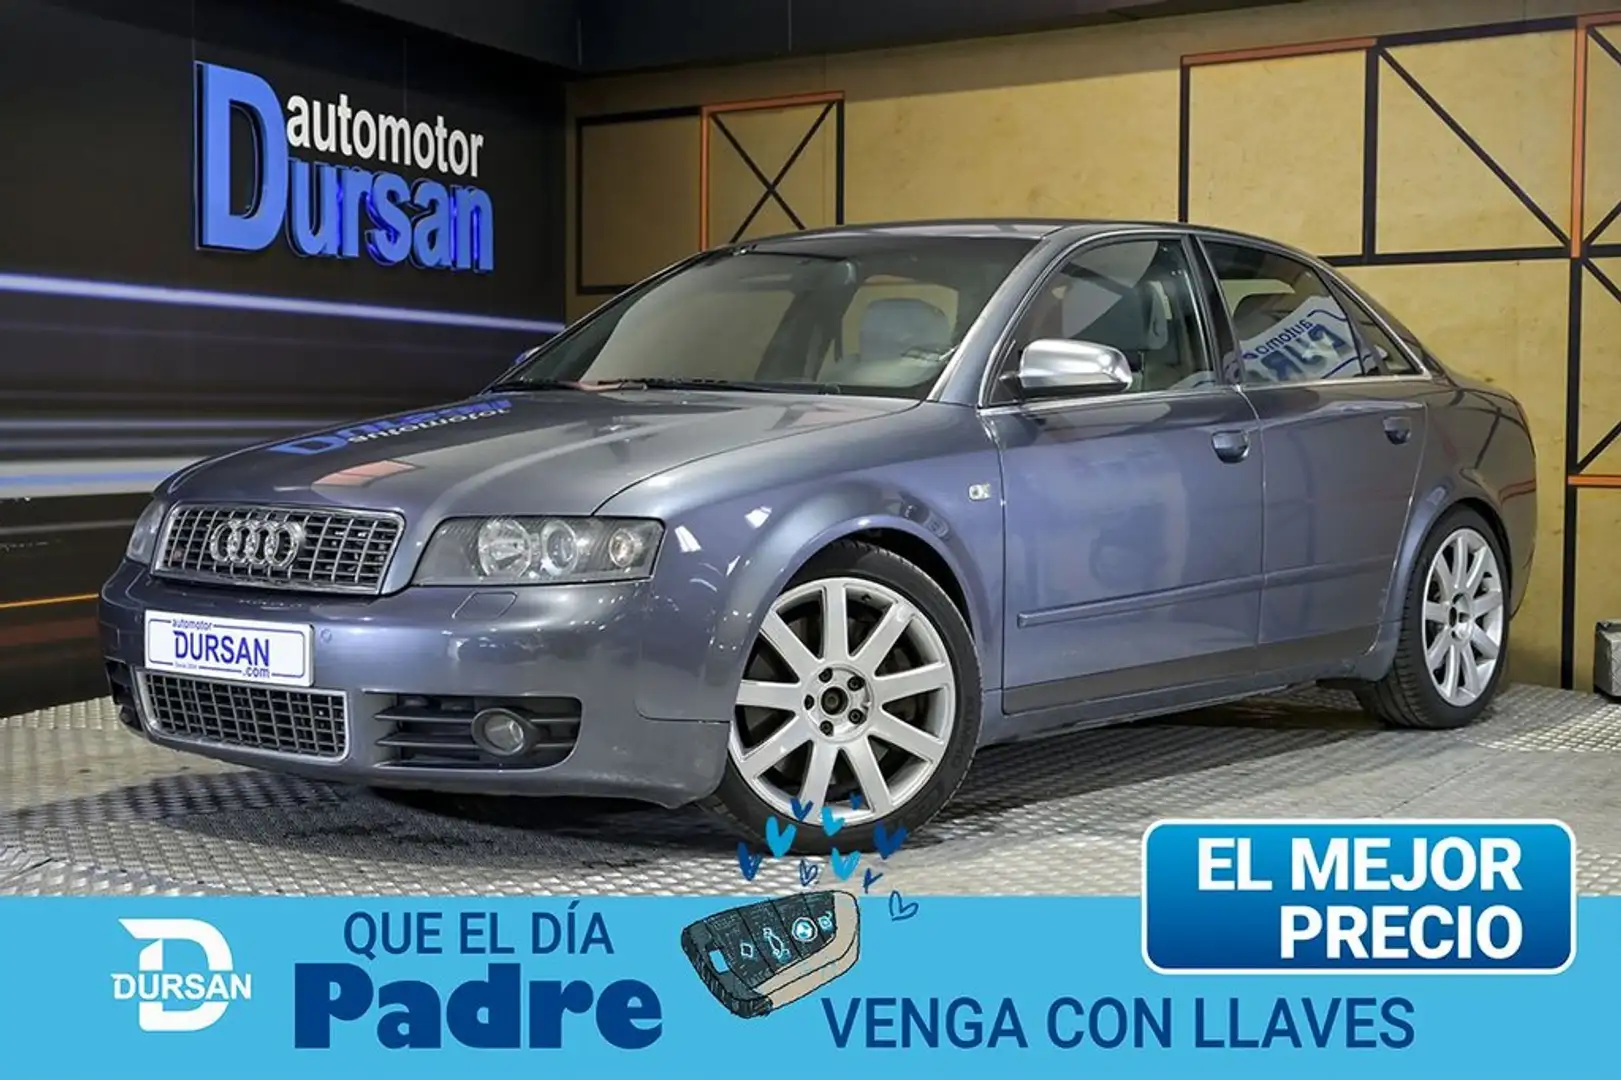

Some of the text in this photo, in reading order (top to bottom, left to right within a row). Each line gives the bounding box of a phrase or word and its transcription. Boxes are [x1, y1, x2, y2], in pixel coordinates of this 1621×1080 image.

[286, 93, 484, 177] automotor
[193, 60, 494, 273] Dursan
[171, 618, 213, 631] automotor
[172, 630, 270, 667] DURSAN
[242, 666, 270, 679] .com
